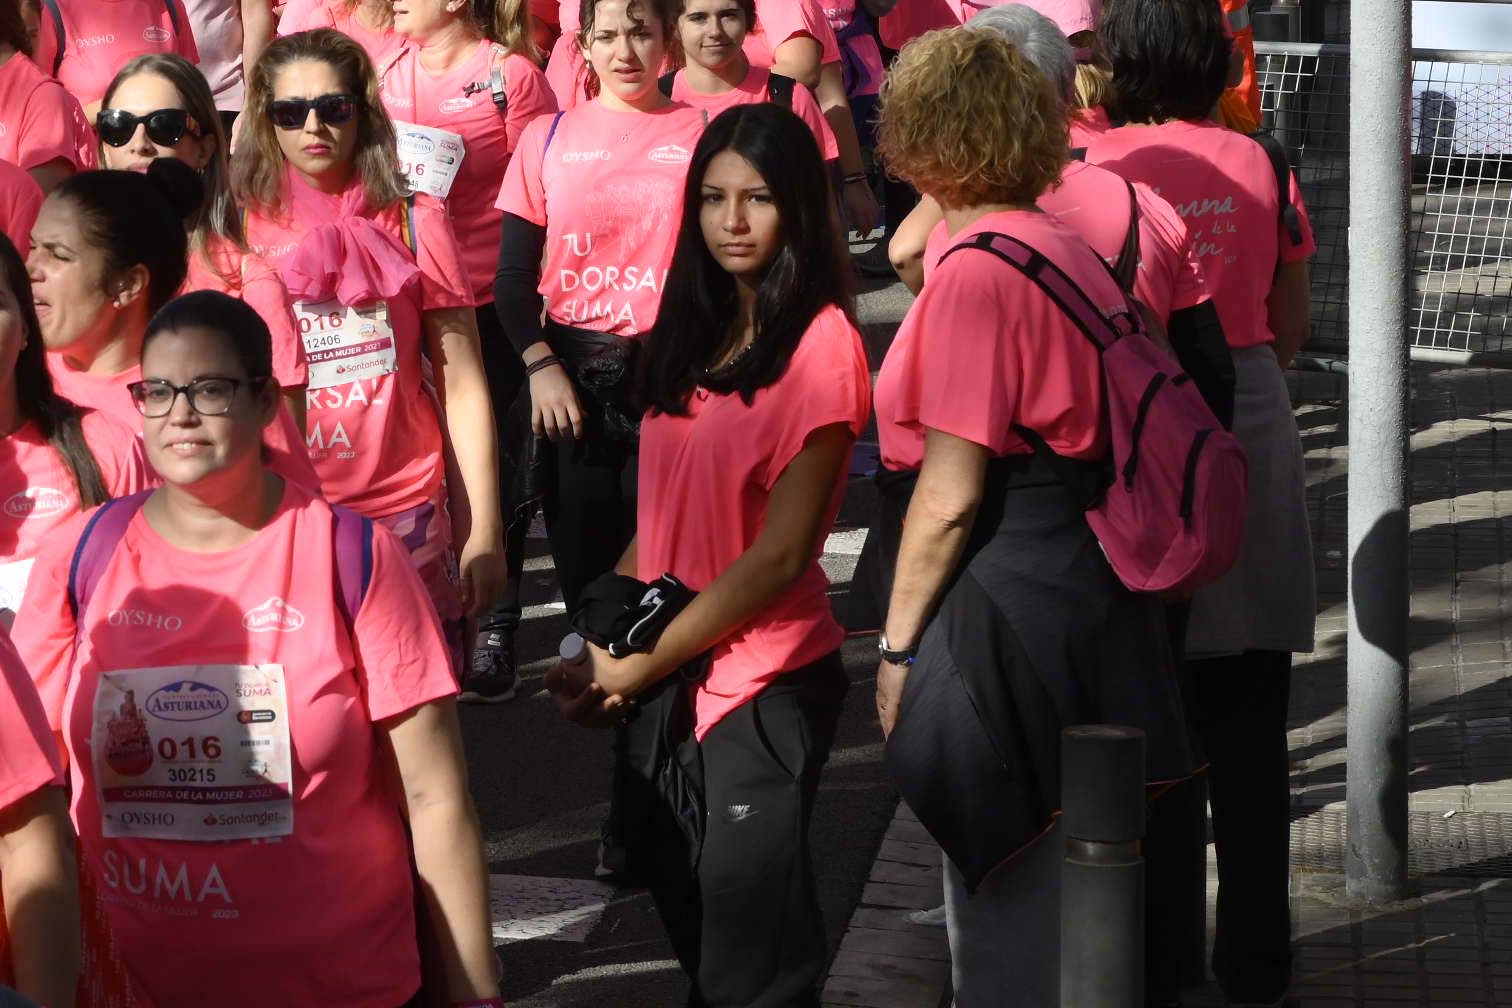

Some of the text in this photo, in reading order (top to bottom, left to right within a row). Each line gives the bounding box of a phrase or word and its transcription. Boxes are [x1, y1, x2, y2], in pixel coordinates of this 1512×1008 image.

[406, 163, 425, 176] 16
[562, 233, 593, 257] TU
[563, 300, 637, 328] SUMA
[299, 312, 343, 334] 016
[306, 335, 341, 349] 12406
[312, 353, 323, 361] DE
[324, 350, 334, 359] LA
[335, 346, 361, 357] MUJER
[306, 378, 384, 409] RSAL
[108, 610, 182, 632] OYSHO
[235, 687, 272, 698] SUMA
[148, 697, 223, 713] ASTURIANA
[158, 735, 222, 760] 016
[168, 767, 216, 782] 30215
[123, 789, 173, 800] CARRERA
[176, 790, 188, 800] DE
[191, 791, 204, 801] LA
[206, 790, 243, 800] MUJER
[121, 811, 175, 826] OYSHO
[219, 811, 279, 826] Santander
[103, 848, 233, 903] SUMA
